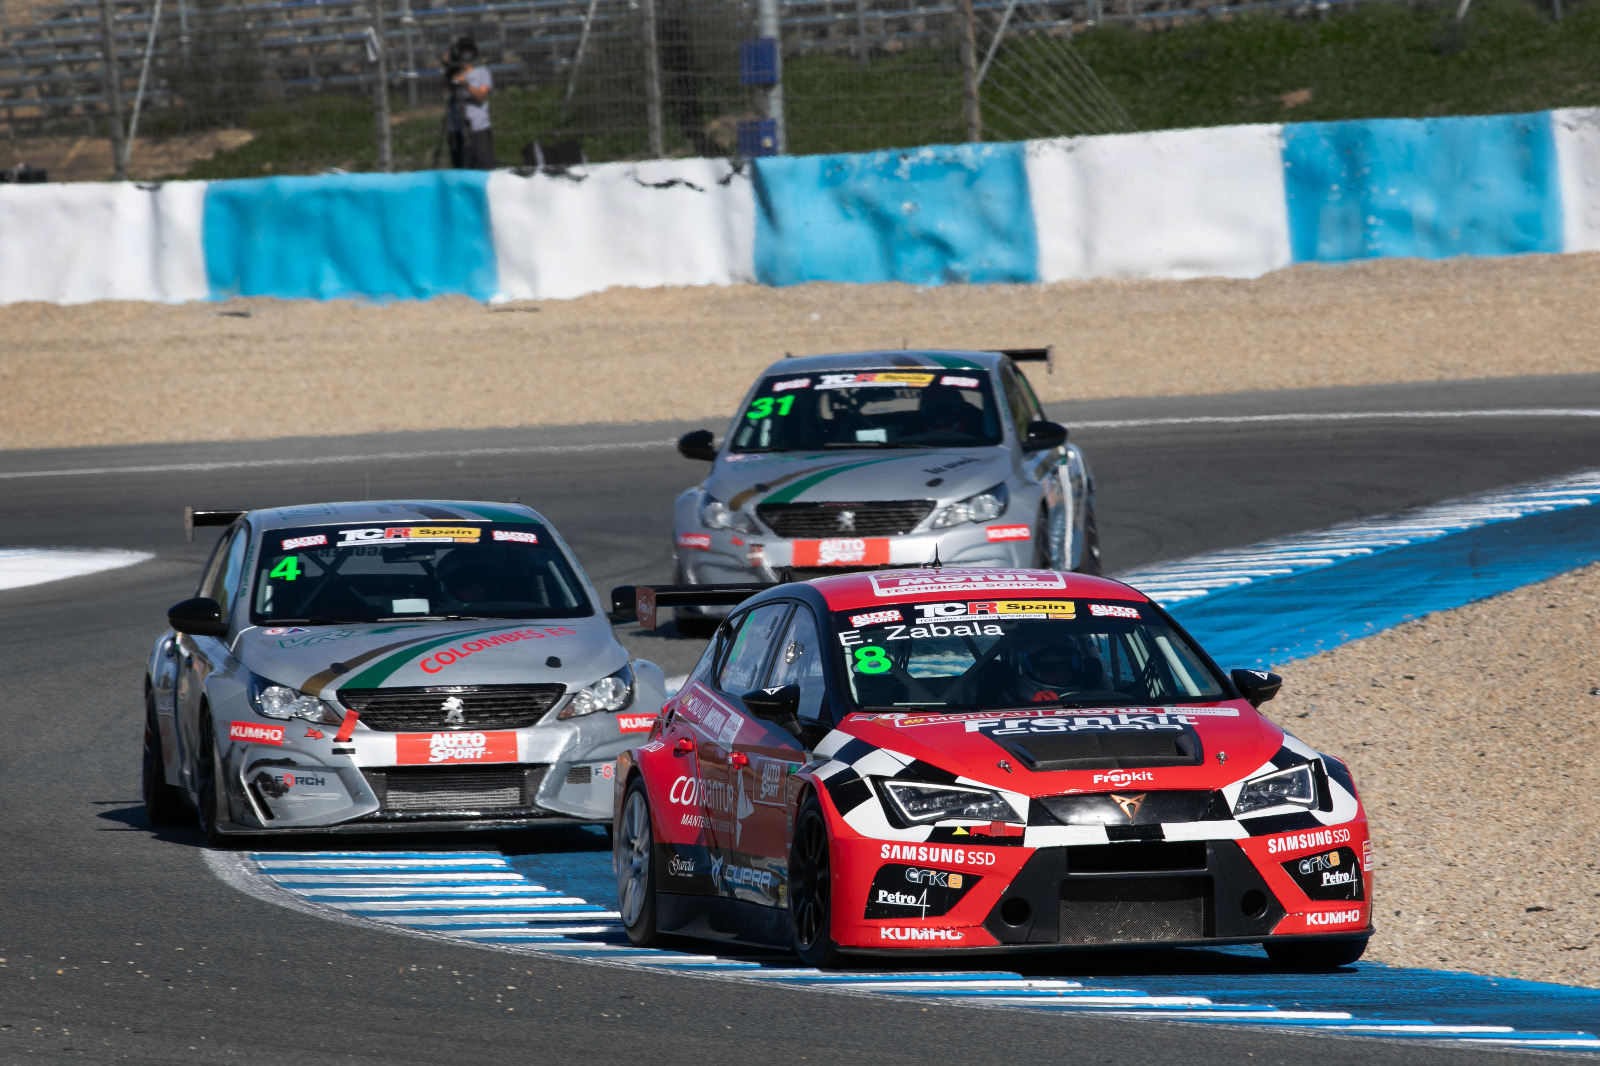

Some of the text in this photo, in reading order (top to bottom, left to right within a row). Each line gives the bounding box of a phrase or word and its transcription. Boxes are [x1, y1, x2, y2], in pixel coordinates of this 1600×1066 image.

[746, 394, 796, 420] 31
[338, 528, 472, 541] TCR Spain
[269, 556, 301, 581] 4
[885, 581, 1058, 595] TECHNICAL SCHOOL
[899, 575, 1038, 586] MOTUL
[852, 610, 900, 622] AUTO
[915, 601, 1066, 617] TCR Spain
[1090, 604, 1138, 615] AUTO
[853, 616, 902, 627] SPORT
[838, 621, 1005, 646] E. Zabala
[420, 628, 546, 674] COLOMBES
[854, 645, 892, 674] 8
[927, 711, 1032, 723] MONLAU
[964, 714, 1199, 733] Frenkit
[230, 725, 283, 741] KUMHO
[430, 733, 487, 748] AUTO
[429, 747, 485, 762] SPORT
[274, 772, 325, 787] FORCH
[763, 763, 781, 782] AUTO
[1093, 769, 1153, 784] Frenkit
[760, 780, 780, 799] SPORT
[1267, 828, 1351, 854] SAMSUNG SSD
[880, 843, 996, 865] SAMSUNG SSD
[726, 864, 772, 889] CUPRA
[1306, 909, 1360, 925] KUMHO
[880, 927, 965, 940] KUMHO
